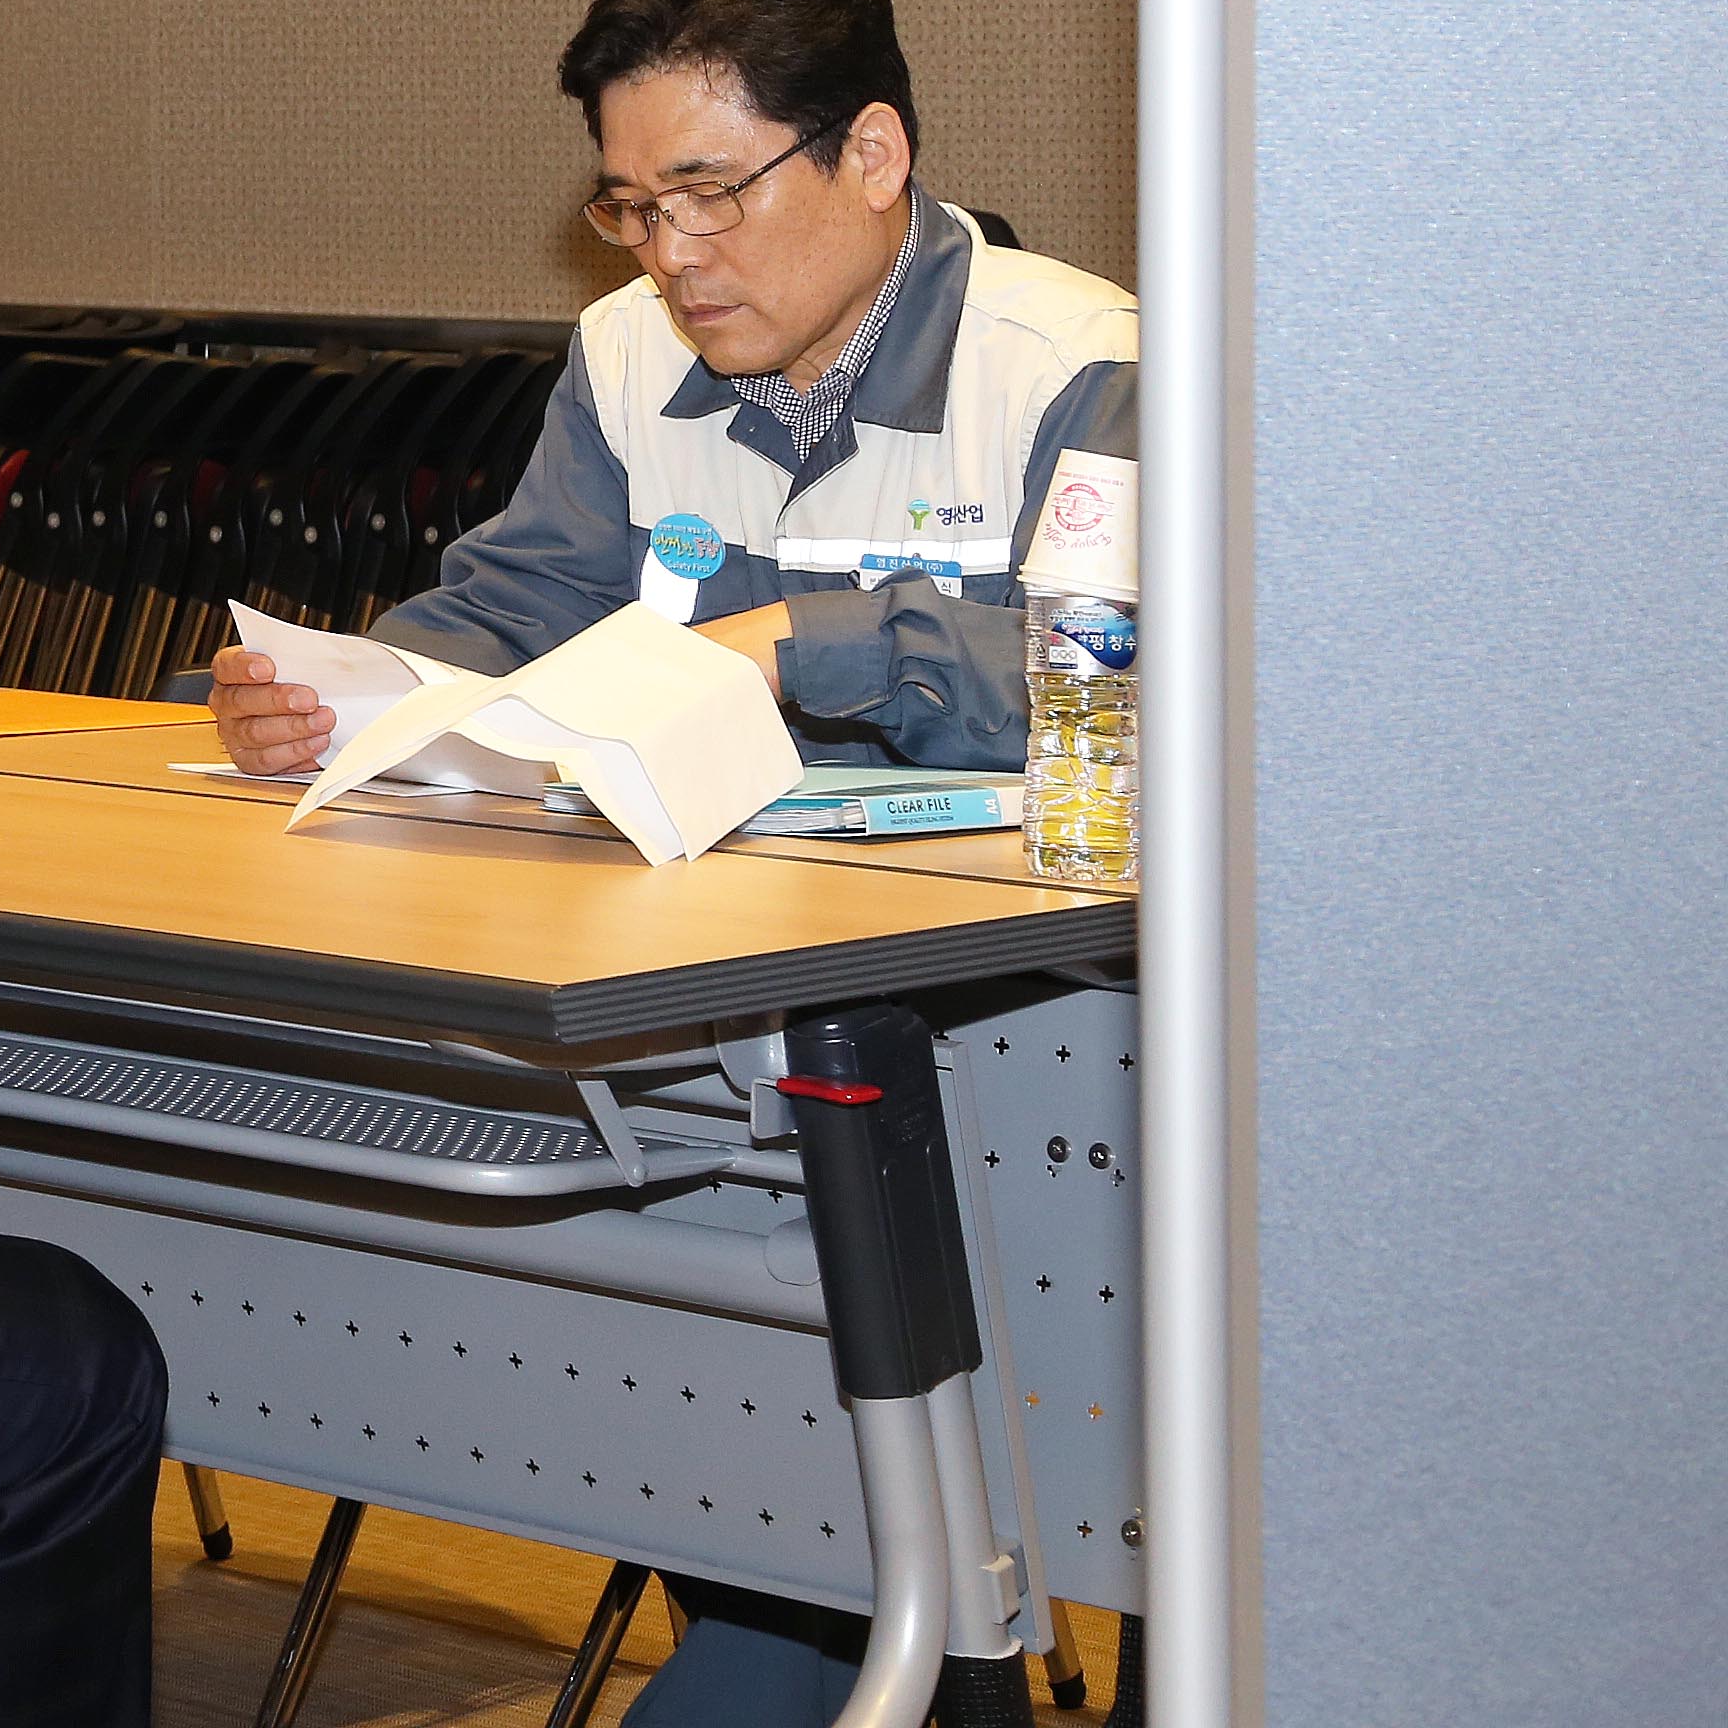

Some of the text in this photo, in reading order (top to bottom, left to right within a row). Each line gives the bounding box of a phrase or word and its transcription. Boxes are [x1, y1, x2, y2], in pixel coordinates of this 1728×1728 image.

[936, 504, 984, 525] 영산업
[887, 798, 951, 814] CLEAR FILE
